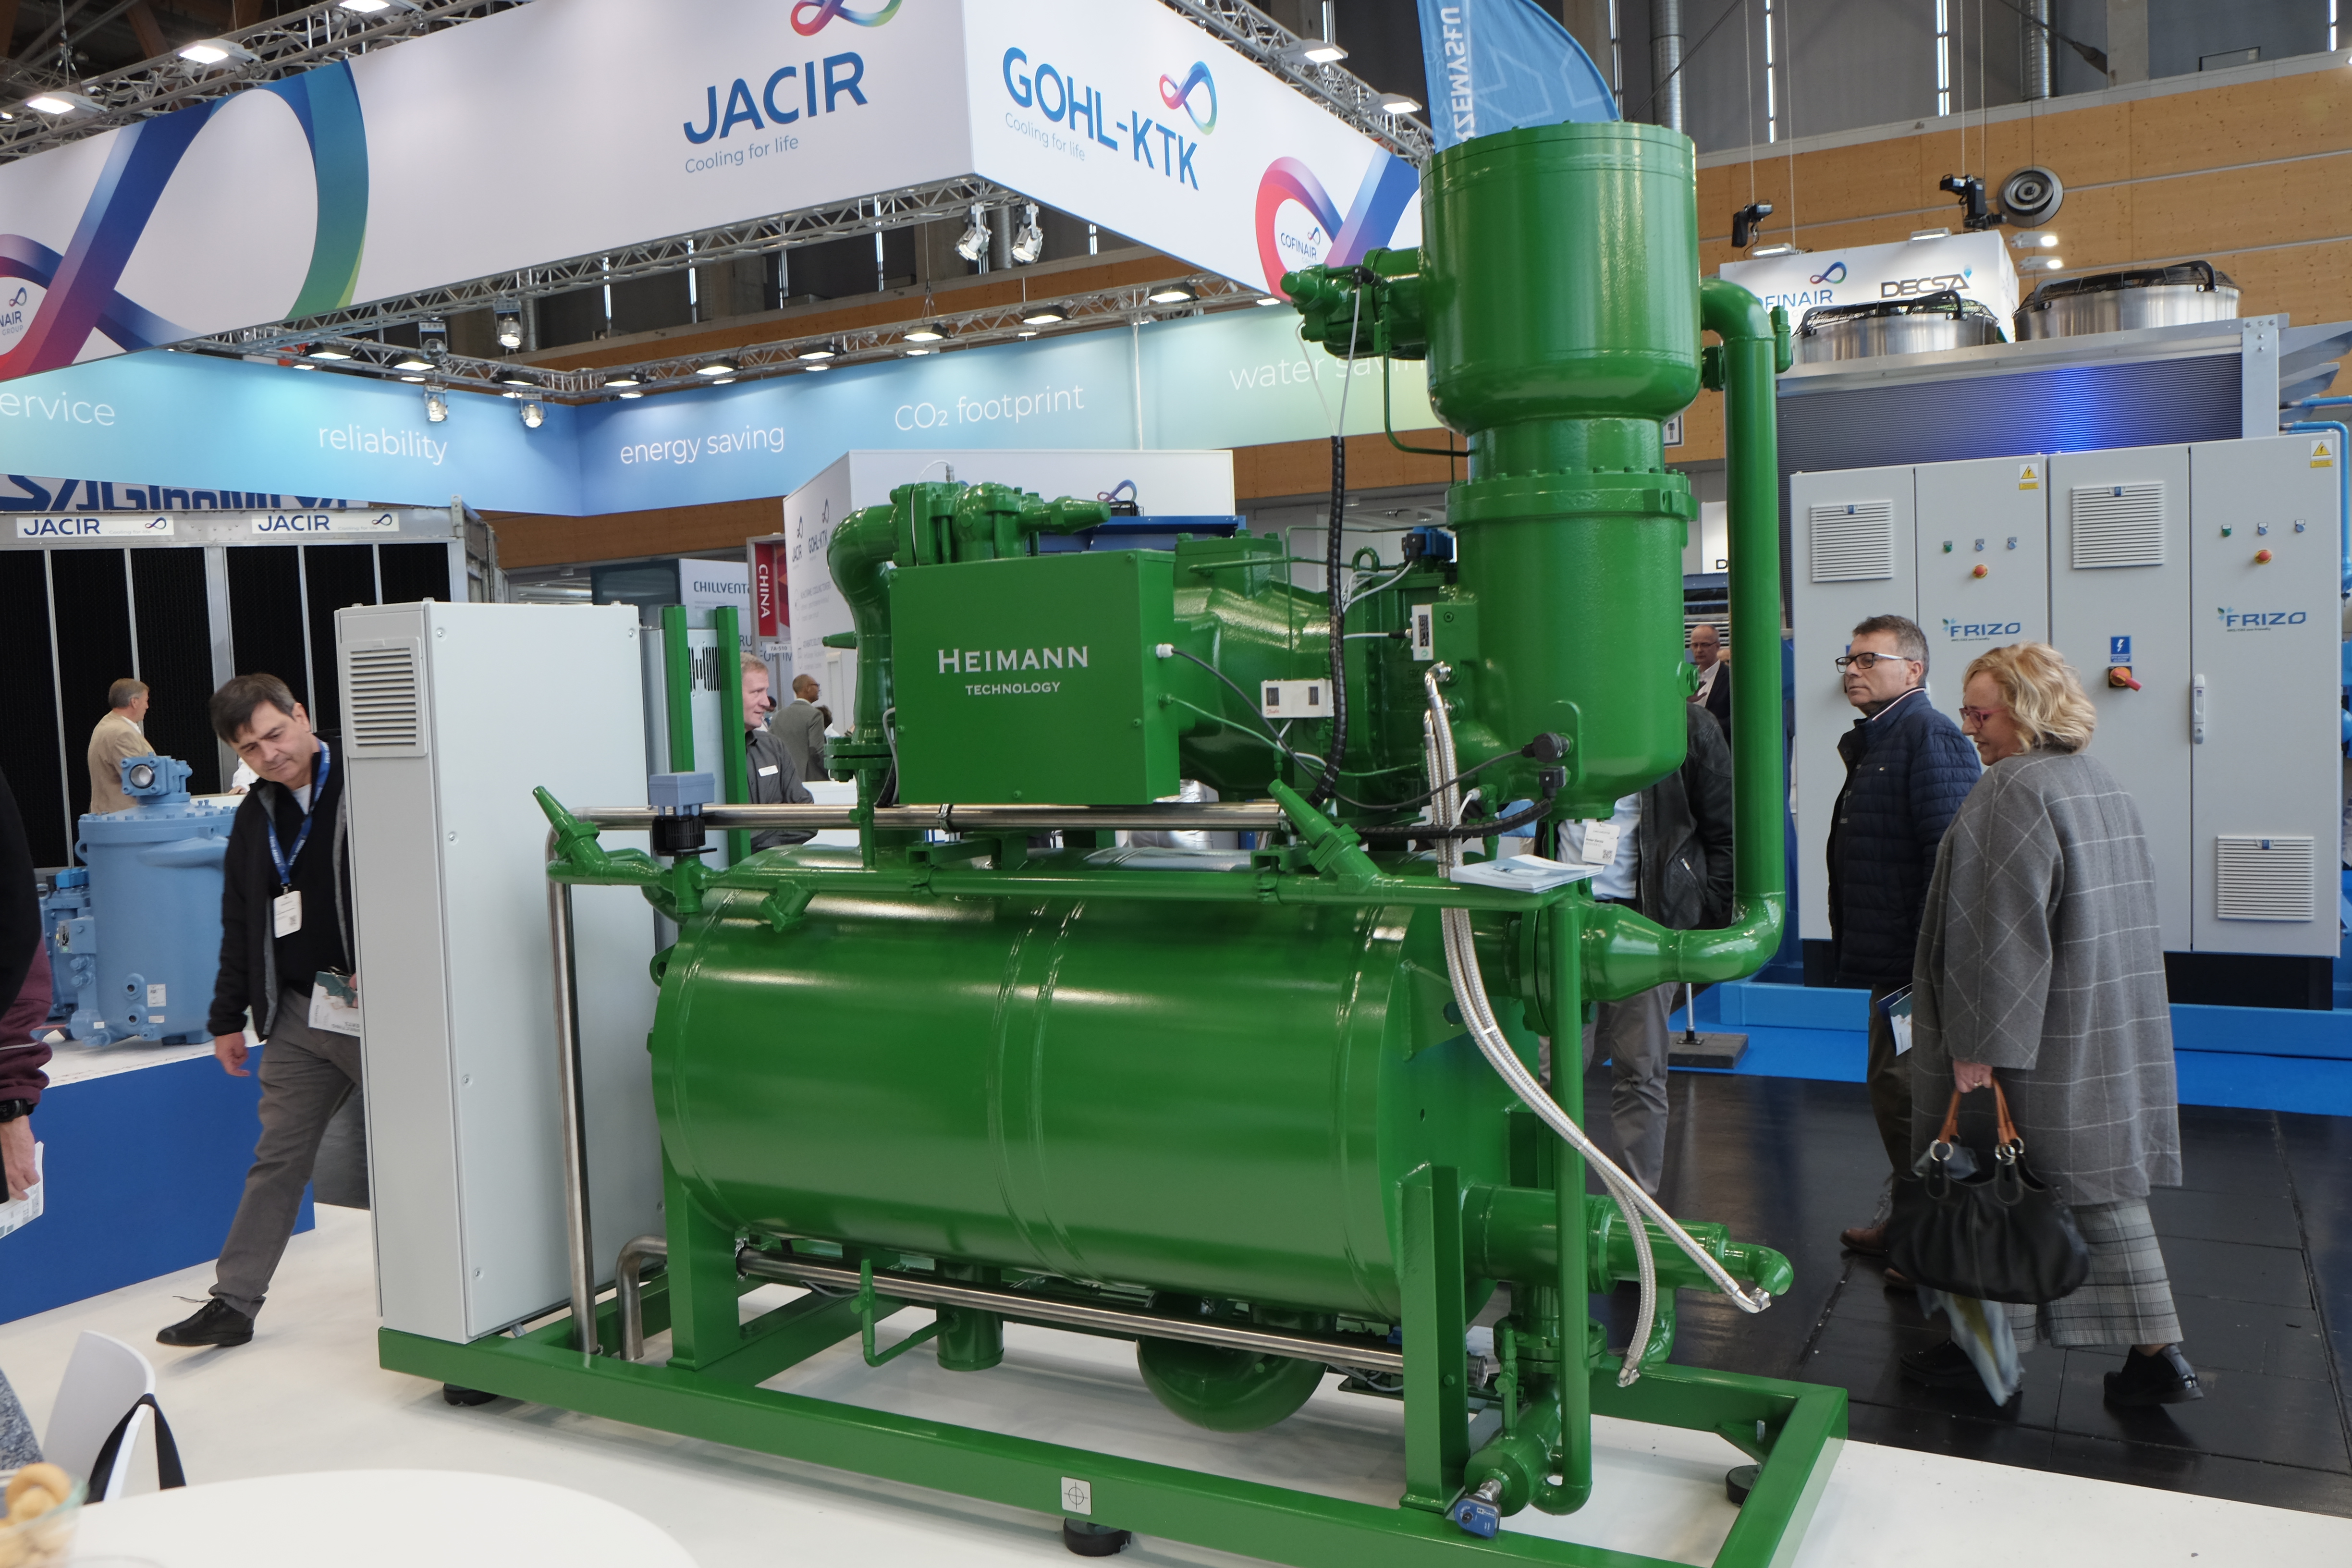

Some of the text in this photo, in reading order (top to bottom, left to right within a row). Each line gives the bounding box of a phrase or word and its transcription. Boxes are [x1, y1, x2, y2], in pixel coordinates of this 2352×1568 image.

[683, 51, 868, 144] JACIR
[1003, 47, 1199, 191] GOHL-KTK
[1005, 112, 1086, 161] Cooling for life
[685, 135, 799, 173] Cooling for life
[1280, 233, 1317, 260] COFINAIR
[1881, 273, 1970, 299] DECSA
[2, 325, 23, 336] GROUP
[1229, 357, 1325, 391] water
[895, 385, 1084, 431] CO2 footprint
[319, 424, 448, 466] reliability
[621, 425, 784, 465] energy saving
[24, 518, 101, 536] JACIR
[258, 514, 331, 532] JACIR
[759, 564, 771, 618] CHINA
[1950, 622, 2021, 637] FRIZO
[2227, 612, 2306, 627] FRIZO
[938, 646, 1088, 674] HEIMANN
[965, 682, 1061, 696] TECHNOLOGY
